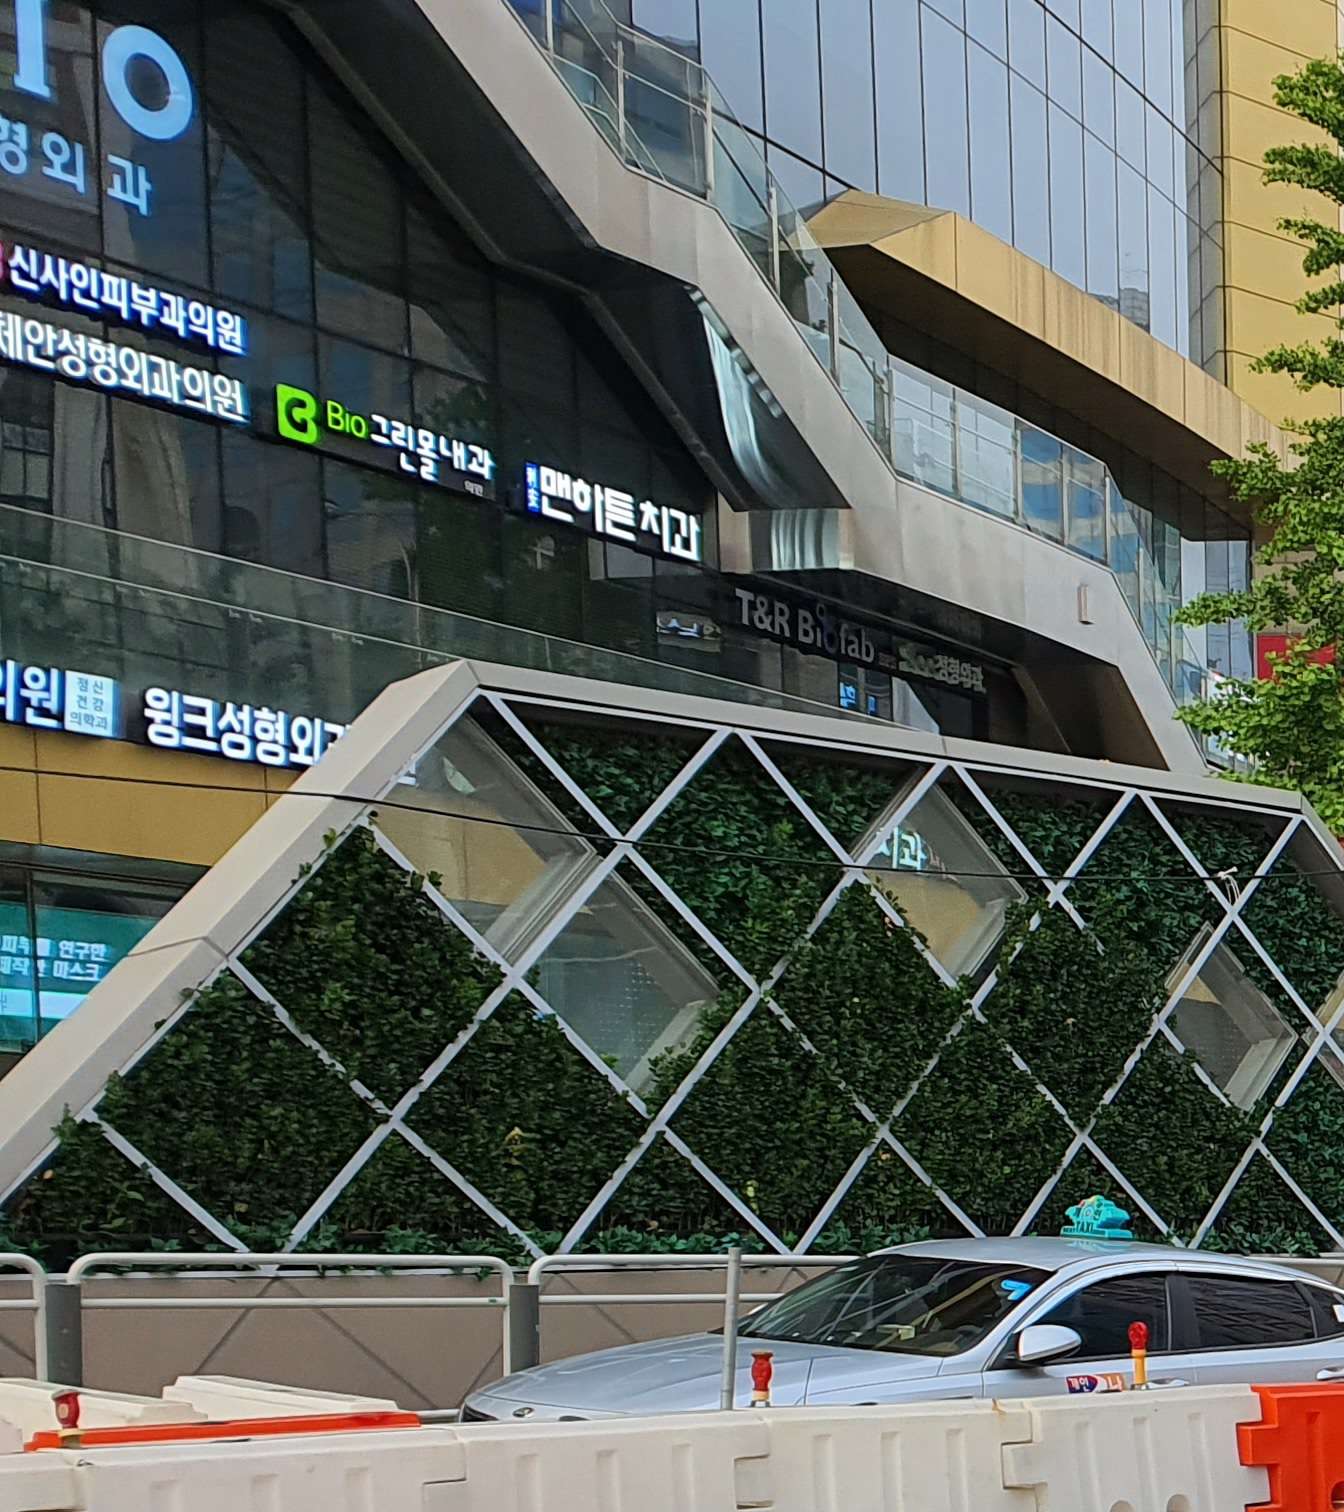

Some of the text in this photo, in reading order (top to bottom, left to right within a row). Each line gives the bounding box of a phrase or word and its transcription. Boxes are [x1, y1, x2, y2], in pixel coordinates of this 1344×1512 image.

[8, 243, 247, 357] 신사인피부과의원
[735, 588, 791, 637] T&R
[53, 960, 100, 982] 마스크
